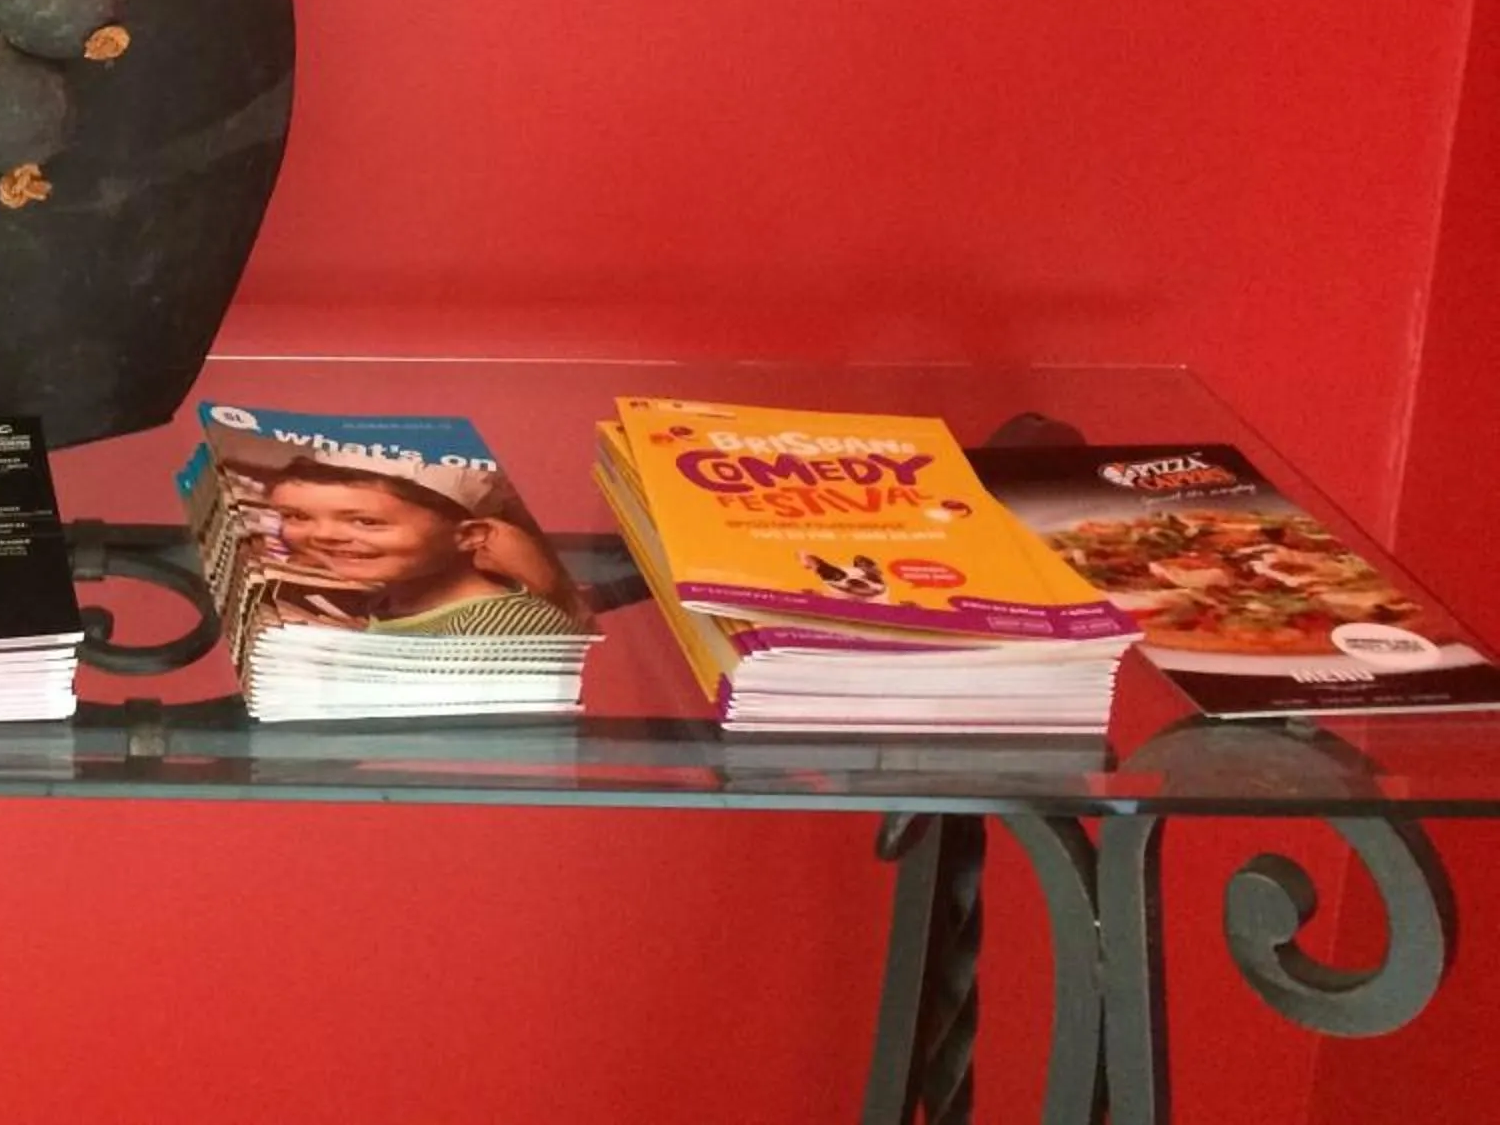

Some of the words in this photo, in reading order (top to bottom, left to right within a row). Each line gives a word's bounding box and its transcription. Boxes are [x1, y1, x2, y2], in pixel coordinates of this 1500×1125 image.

[272, 428, 423, 461] what's
[440, 454, 497, 472] on
[675, 449, 936, 494] COMEDY
[716, 486, 933, 519] FESTIVAL
